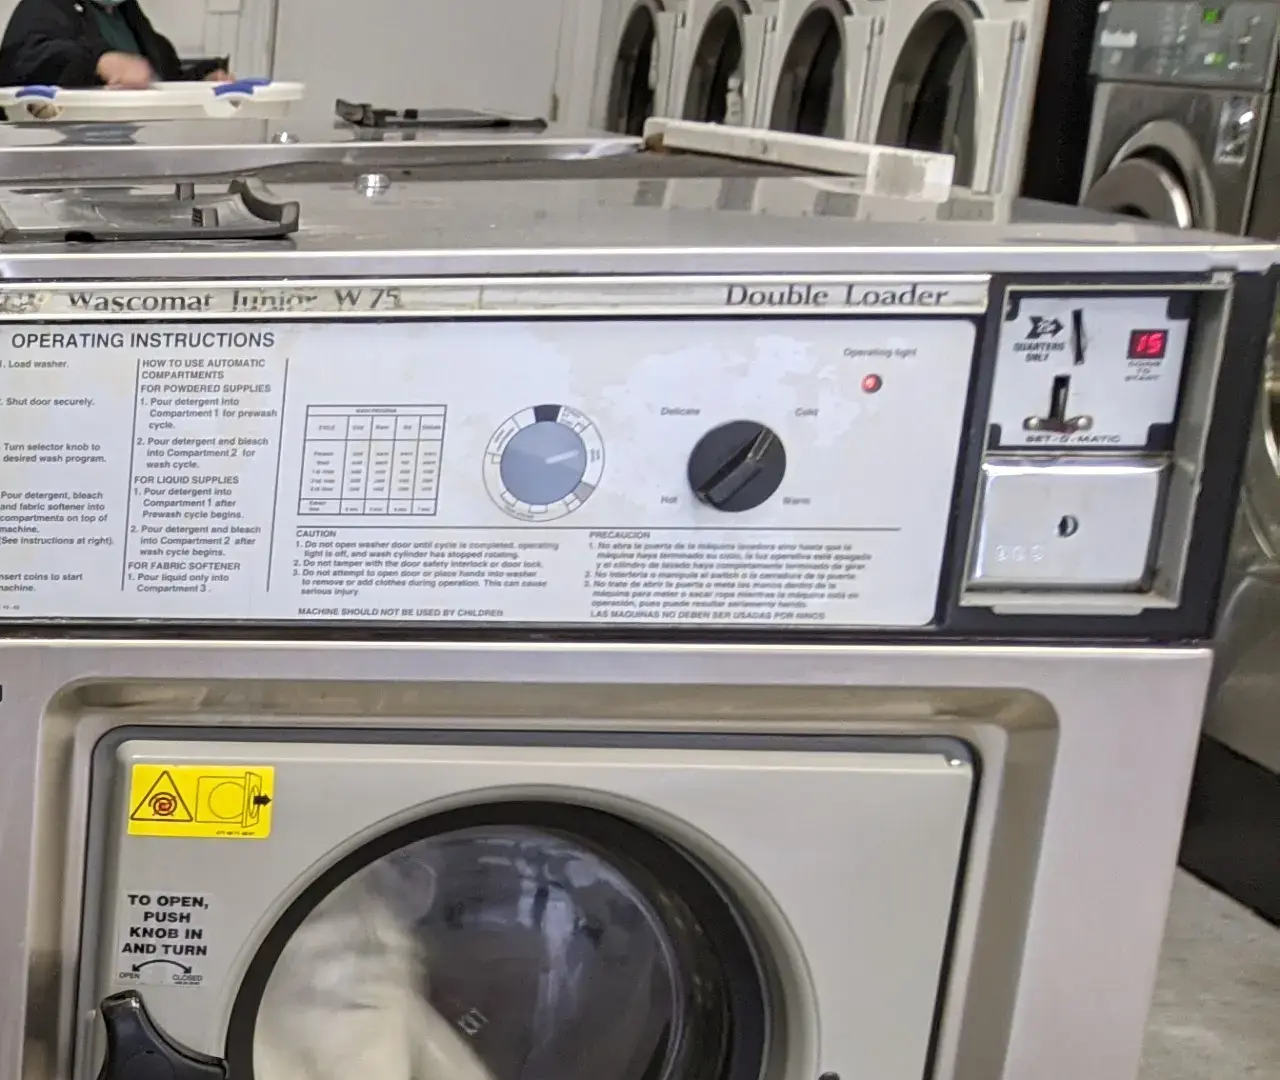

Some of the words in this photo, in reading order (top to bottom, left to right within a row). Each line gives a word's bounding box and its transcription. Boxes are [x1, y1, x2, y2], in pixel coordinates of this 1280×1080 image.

[725, 285, 830, 306] Double
[845, 285, 949, 306] Loader
[68, 293, 213, 312] Wascomat
[335, 291, 359, 309] W
[370, 289, 399, 309] 75
[11, 333, 124, 348] OPERATING
[131, 332, 274, 347] INSTRUCTIONS
[1135, 334, 1162, 352] 15
[844, 348, 892, 358] Operating
[895, 347, 916, 358] light
[9, 360, 31, 368] Load
[143, 359, 165, 367] HOW
[169, 359, 182, 367] TO
[185, 359, 204, 367] USE
[207, 359, 265, 367] AUTOMATIC
[142, 371, 224, 379] COMPARTMENTS
[141, 385, 161, 393] FOR
[164, 384, 220, 393] POWDERED
[223, 384, 271, 392] SUPPLIES
[6, 398, 26, 406] Shut
[29, 398, 51, 406] door
[661, 407, 700, 415] Delicate
[135, 476, 154, 484] FOR
[157, 476, 190, 485] LIQUID
[193, 476, 238, 484] SUPPLIES
[661, 495, 677, 504] Hot
[0, 503, 16, 511] and
[19, 503, 45, 511] fabric
[48, 503, 85, 511] softener
[88, 503, 104, 511] into
[0, 515, 64, 523] compartments
[81, 515, 96, 524] top
[20, 537, 74, 545] instructions
[78, 537, 85, 545] at
[128, 562, 147, 570] FOR
[150, 562, 186, 570] FABRIC
[189, 562, 240, 570] SOFTENER
[128, 895, 152, 907] TO
[157, 895, 209, 909] OPEN,
[144, 911, 191, 923] PUSH
[130, 928, 179, 939] KNOB
[185, 928, 202, 939] IN
[122, 943, 156, 954] AND
[162, 944, 207, 956] TURN
